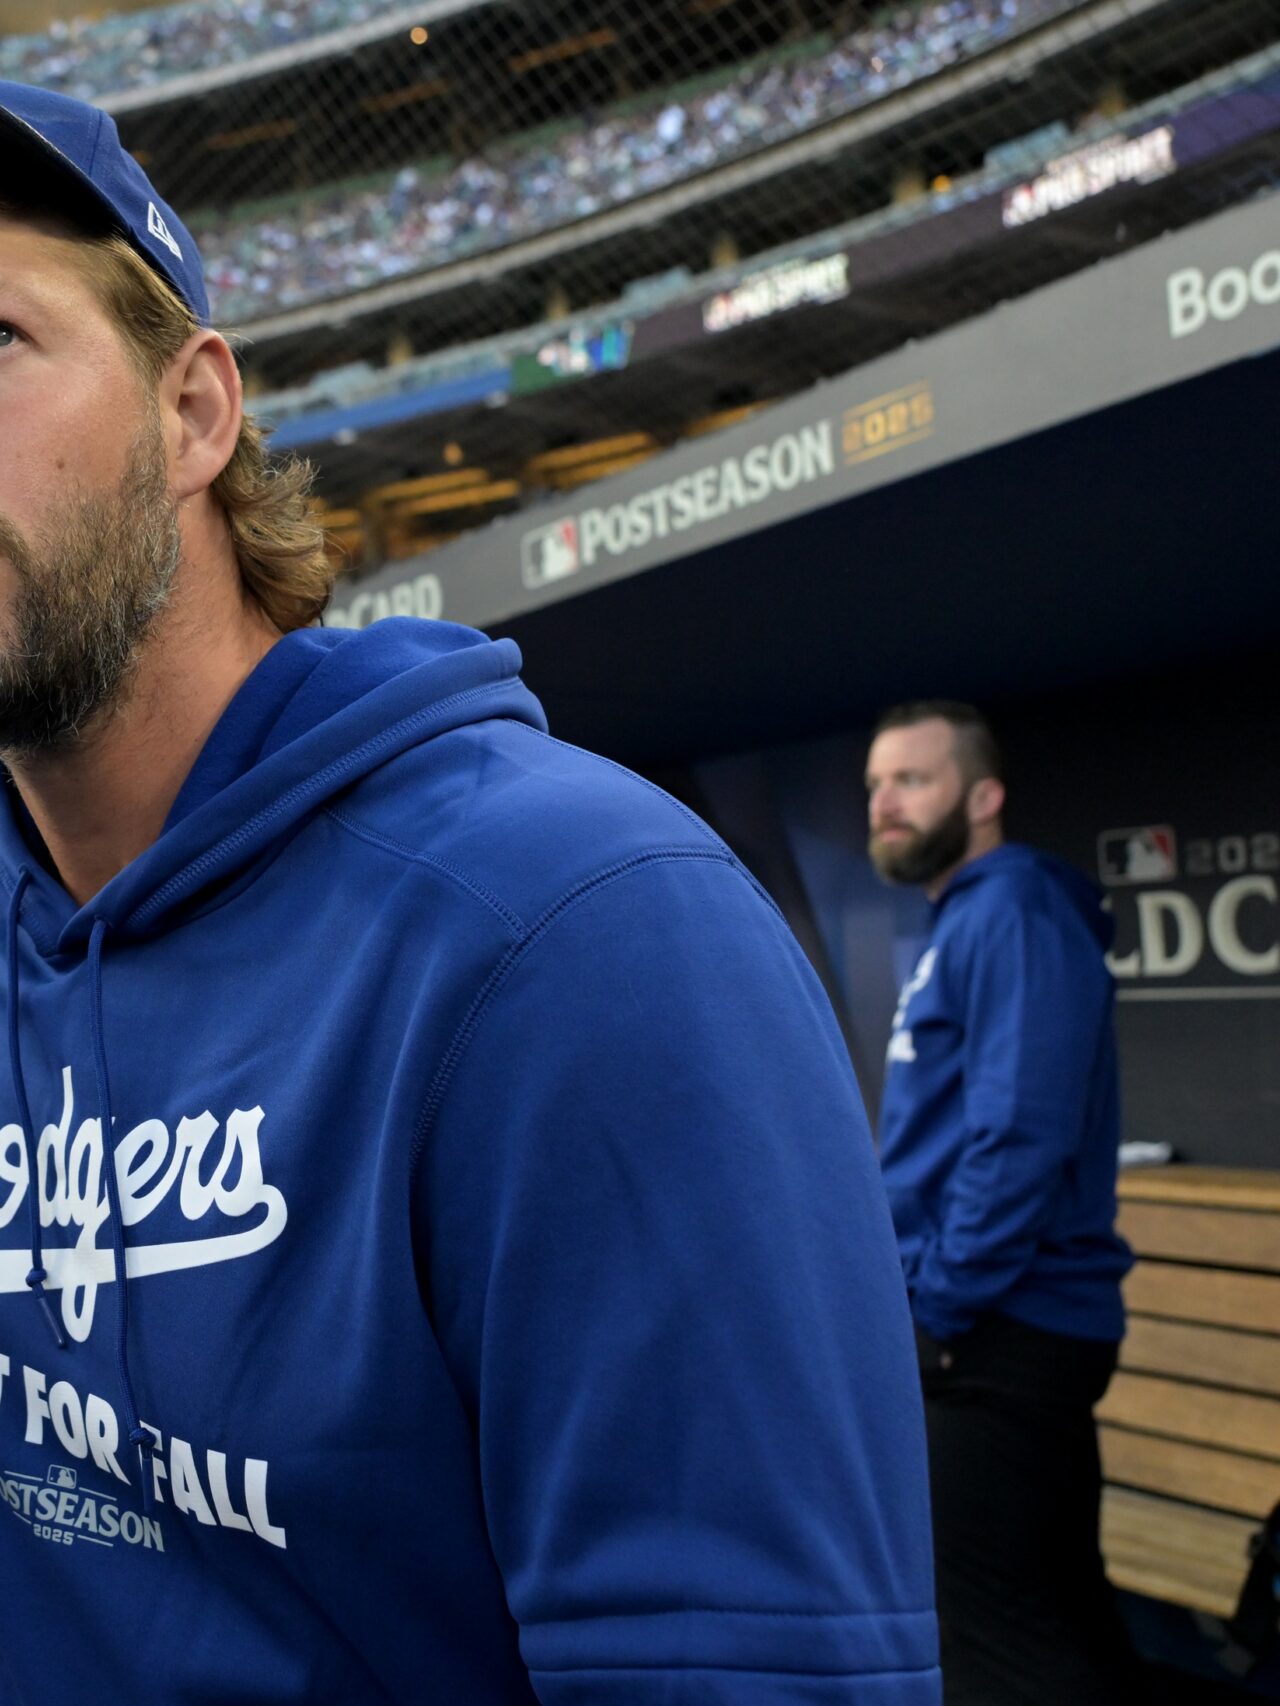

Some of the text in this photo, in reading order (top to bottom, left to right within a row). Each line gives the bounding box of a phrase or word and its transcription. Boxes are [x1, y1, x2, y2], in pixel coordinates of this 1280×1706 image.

[580, 420, 835, 565] POSTSEASON
[23, 1365, 131, 1486] FOR
[33, 1523, 74, 1546] 2025
